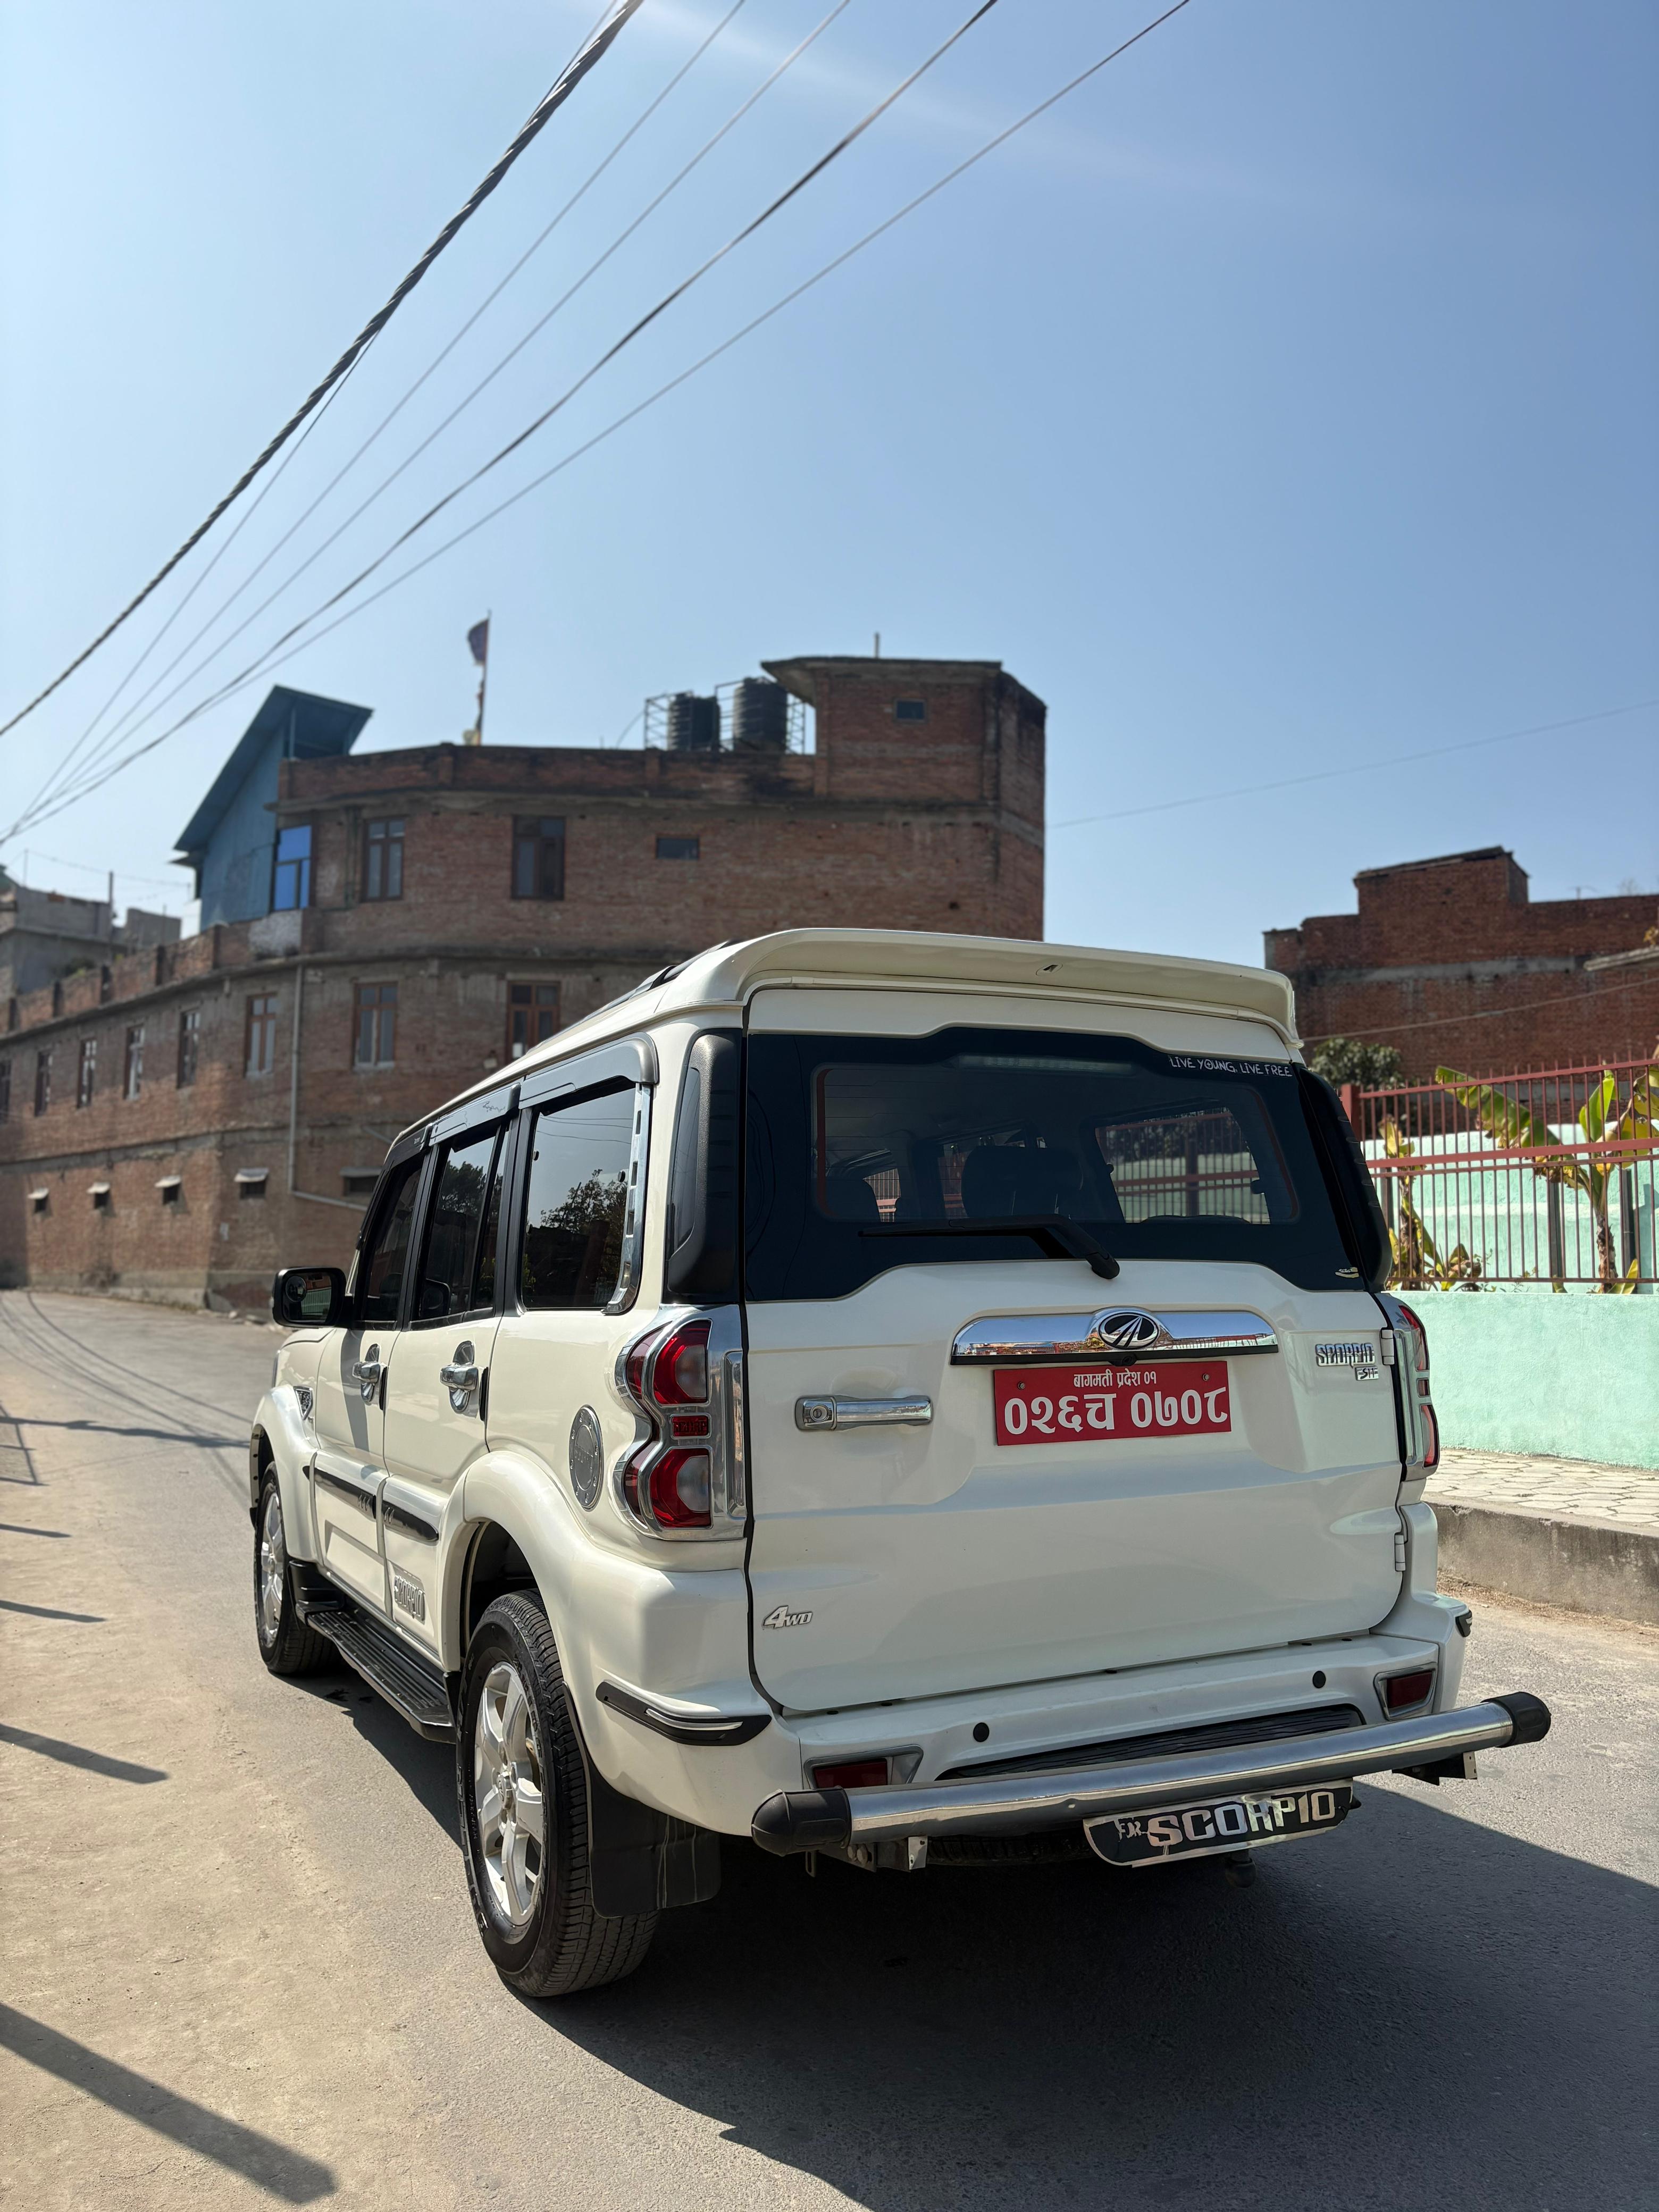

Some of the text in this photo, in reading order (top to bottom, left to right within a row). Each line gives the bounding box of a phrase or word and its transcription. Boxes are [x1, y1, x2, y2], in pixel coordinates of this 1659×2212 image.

[1169, 1056, 1293, 1077] LIVE YOUNG, LIVE FREE
[1316, 1343, 1375, 1369] SCORPIO
[1074, 1368, 1157, 1388] बागमती प्रदेश ०१
[1130, 1387, 1228, 1429] ०७०८
[1147, 1791, 1335, 1847] SCORPIO
